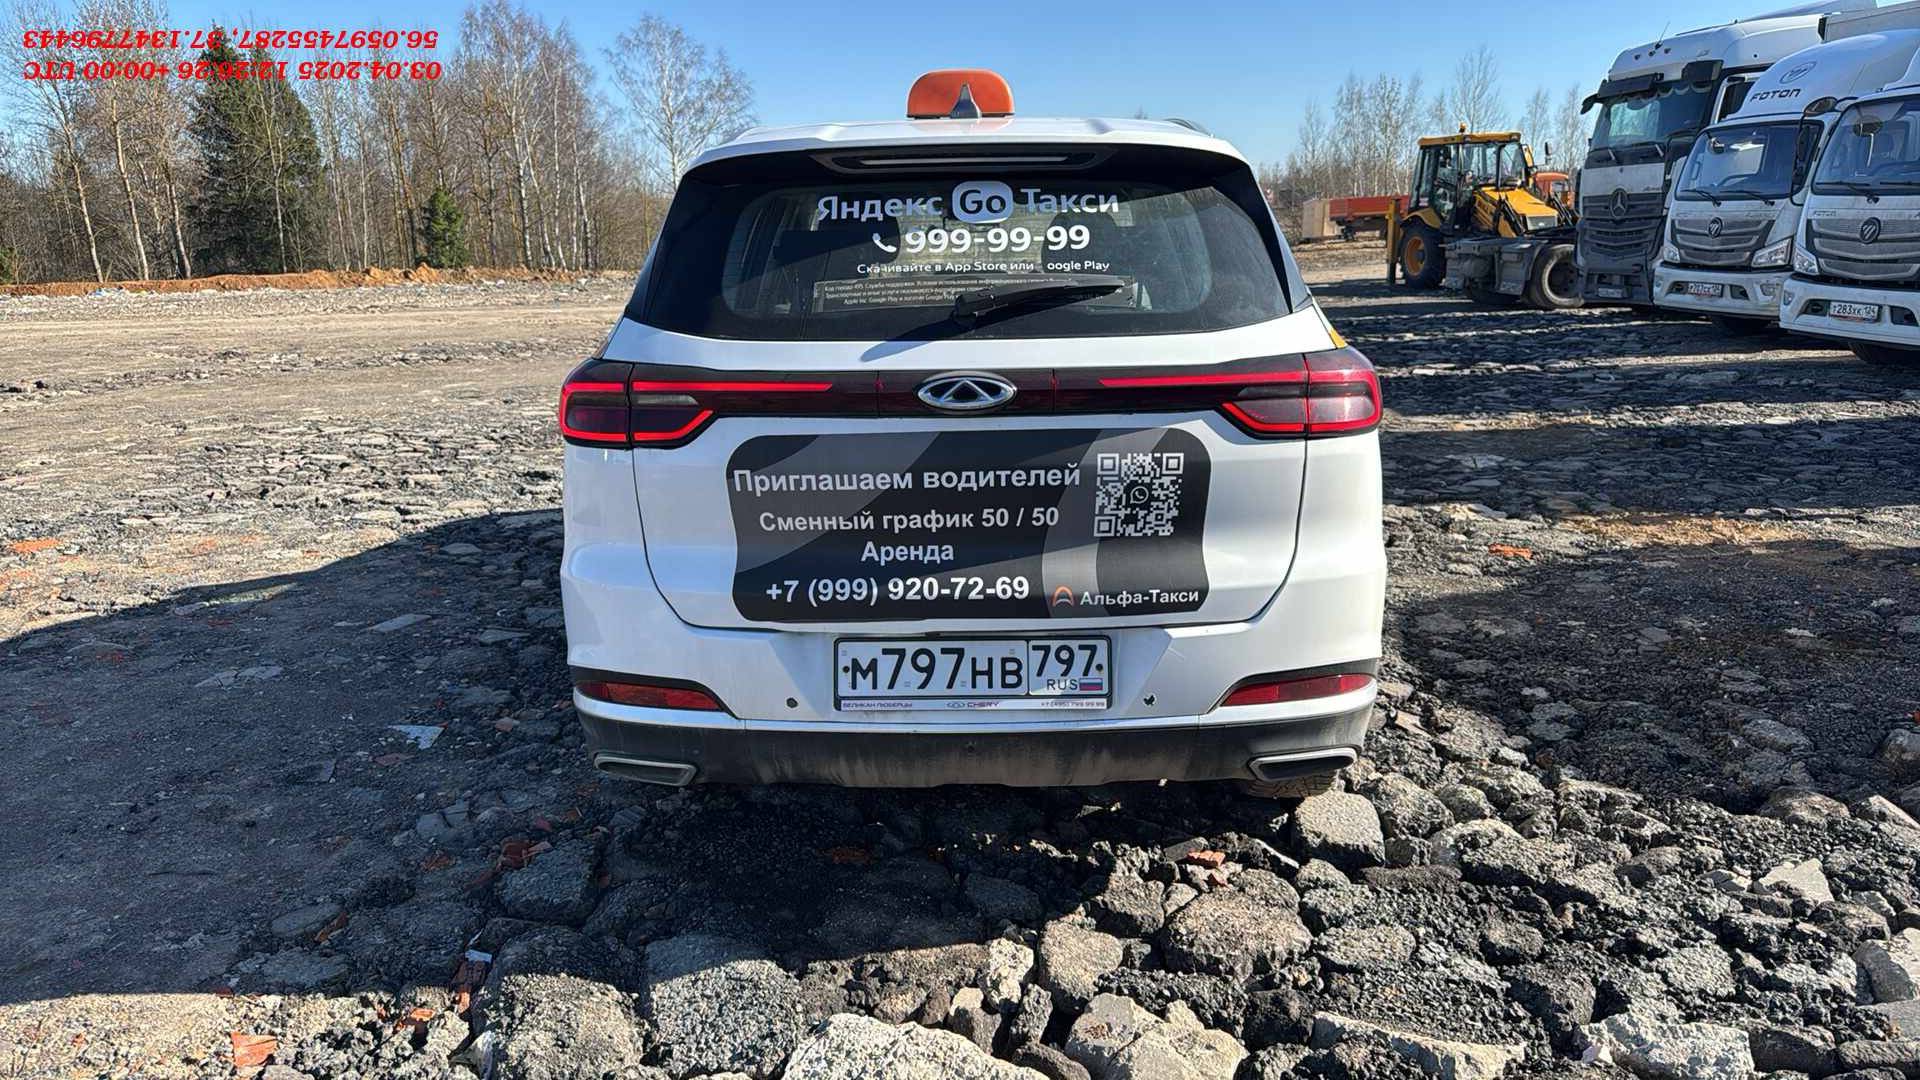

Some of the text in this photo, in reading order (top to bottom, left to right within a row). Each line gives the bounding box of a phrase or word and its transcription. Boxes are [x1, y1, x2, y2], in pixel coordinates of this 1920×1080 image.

[1750, 88, 1801, 102] FOTON
[817, 188, 1119, 221] Яндекс Go Такси
[905, 224, 1090, 253] 999-99-99
[857, 263, 932, 274] Скачивайте
[945, 262, 971, 273] App
[973, 261, 1007, 271] Store
[1047, 261, 1081, 272] oogle
[1084, 260, 1110, 272] Play
[733, 463, 1080, 496] Приглашаем водителей
[759, 507, 1059, 533] Сменный график 50 / 50
[861, 541, 954, 566] Аренда
[766, 576, 1030, 607] +7 (999) 920-72-69
[1080, 590, 1199, 607] Альфа-Такси
[851, 644, 1098, 690] М797НВ 797
[1046, 679, 1077, 690] RUS
